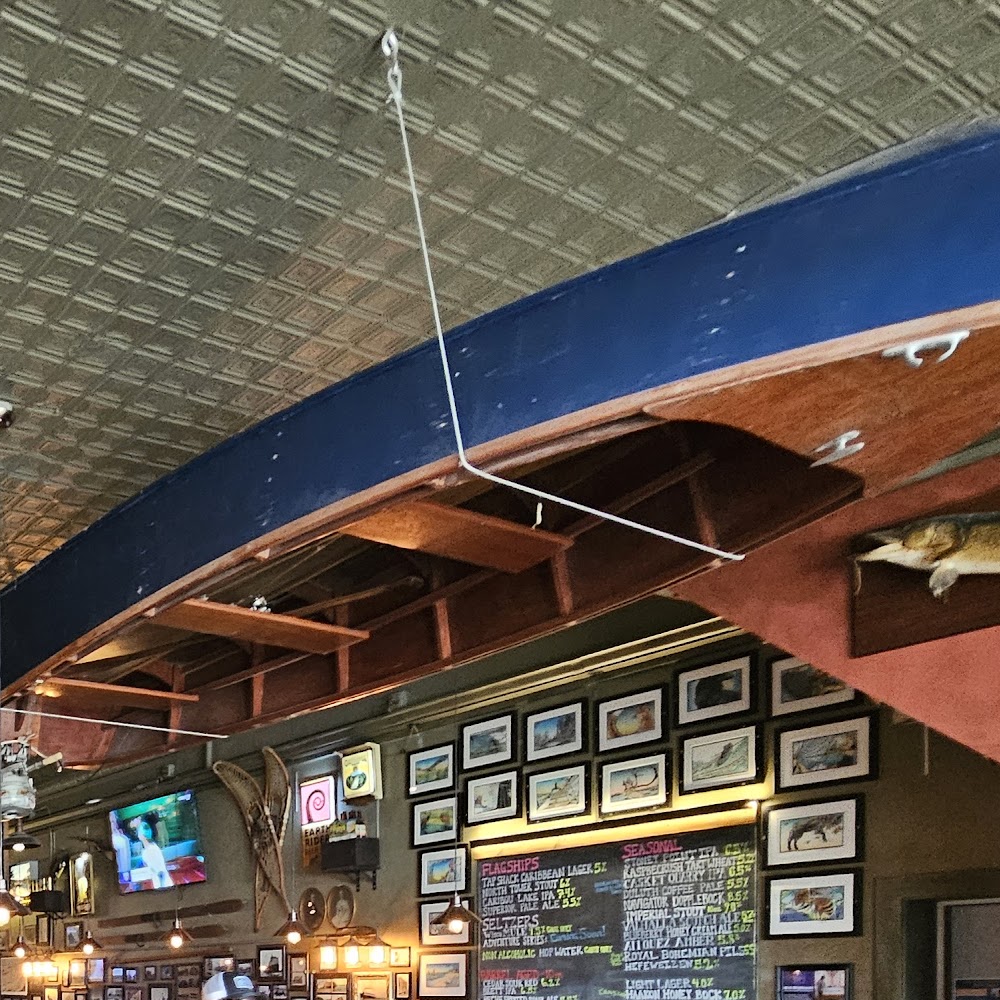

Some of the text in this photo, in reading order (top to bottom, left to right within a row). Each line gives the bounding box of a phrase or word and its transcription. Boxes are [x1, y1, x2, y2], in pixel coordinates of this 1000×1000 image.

[622, 840, 683, 859] SEASONAL
[698, 845, 719, 859] IPA
[481, 857, 540, 876] FLAGSHIPS
[707, 855, 737, 870] WHEAT
[481, 876, 496, 889] TAP
[520, 865, 566, 882] CARIBBEAN
[567, 863, 593, 877] LAGER
[594, 861, 607, 874] 5%
[624, 874, 667, 889] CASKET
[667, 868, 706, 885] QUARRY
[707, 867, 725, 881] IPA
[482, 885, 508, 899] NORTH
[534, 879, 558, 891] STOUT
[623, 886, 659, 900] DULUTH
[662, 882, 695, 896] COFFEE
[700, 880, 725, 893] PALE
[482, 894, 515, 907] CARIBOU
[517, 891, 540, 903] LAKE
[541, 890, 556, 901] IPA
[482, 896, 582, 918] SUPERIOR PALE ALE 5.5%
[623, 896, 669, 911] NAVIGATOR
[621, 917, 677, 932] VALHALLA
[719, 911, 741, 924] ALE
[625, 908, 672, 922] IMPERIAL
[672, 905, 707, 919] STOUT
[482, 914, 539, 931] SELTZERS
[666, 926, 692, 939] HONEY
[691, 924, 718, 937] CREAM
[718, 923, 734, 935] ALE
[674, 936, 715, 949] AMBER
[538, 947, 554, 958] HOP
[554, 945, 584, 958] WATER
[622, 950, 660, 963] ROYAL
[661, 945, 718, 960] BOHEMIAN
[623, 959, 693, 972] HEFEWEIZEN
[625, 979, 656, 990] LIGHT
[657, 977, 692, 989] LAGER
[661, 989, 693, 1000] HONEY
[695, 989, 722, 1000] BOCK
